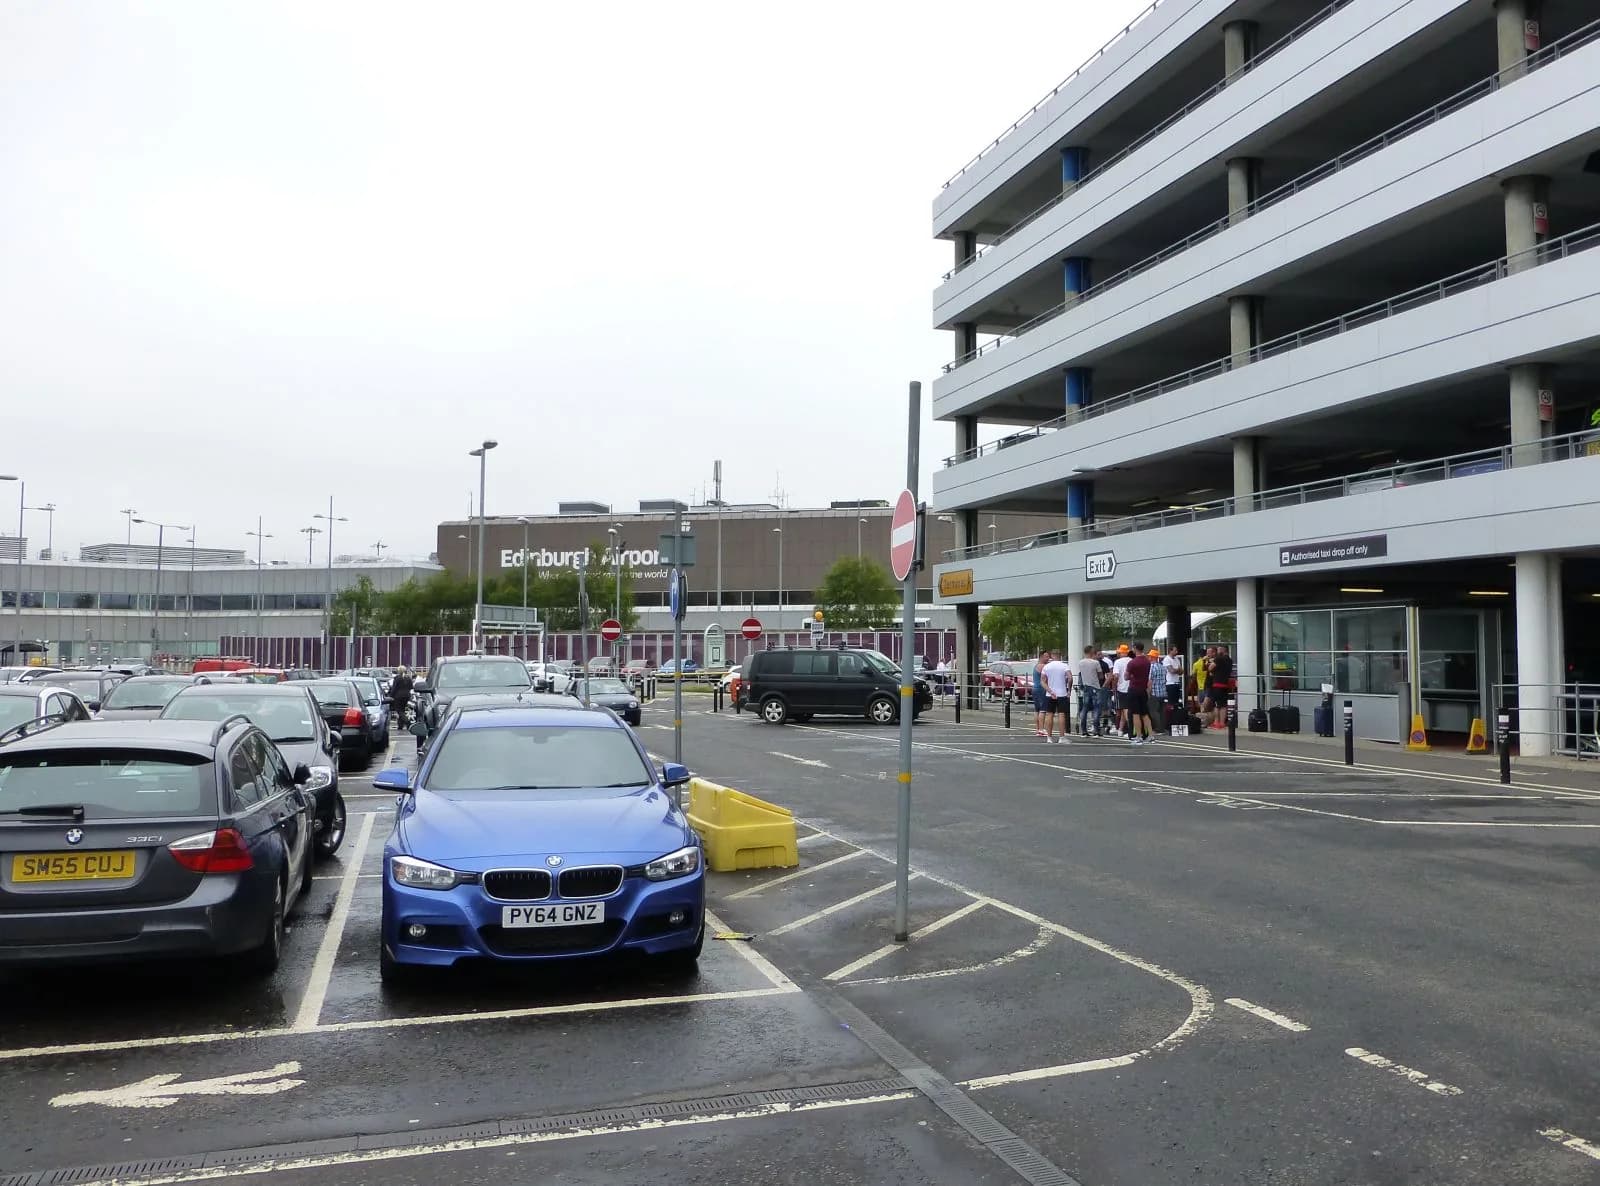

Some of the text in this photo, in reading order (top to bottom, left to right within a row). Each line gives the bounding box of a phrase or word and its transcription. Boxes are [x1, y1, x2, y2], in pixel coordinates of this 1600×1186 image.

[601, 546, 660, 568] Airpor
[1291, 550, 1320, 561] Authorised
[1331, 548, 1345, 558] drop
[1345, 545, 1355, 556] off
[1355, 544, 1368, 556] only
[644, 569, 669, 579] world
[1090, 559, 1106, 573] Exit
[22, 855, 125, 876] SM55 CUJ
[510, 905, 597, 924] PY64 GNZ
